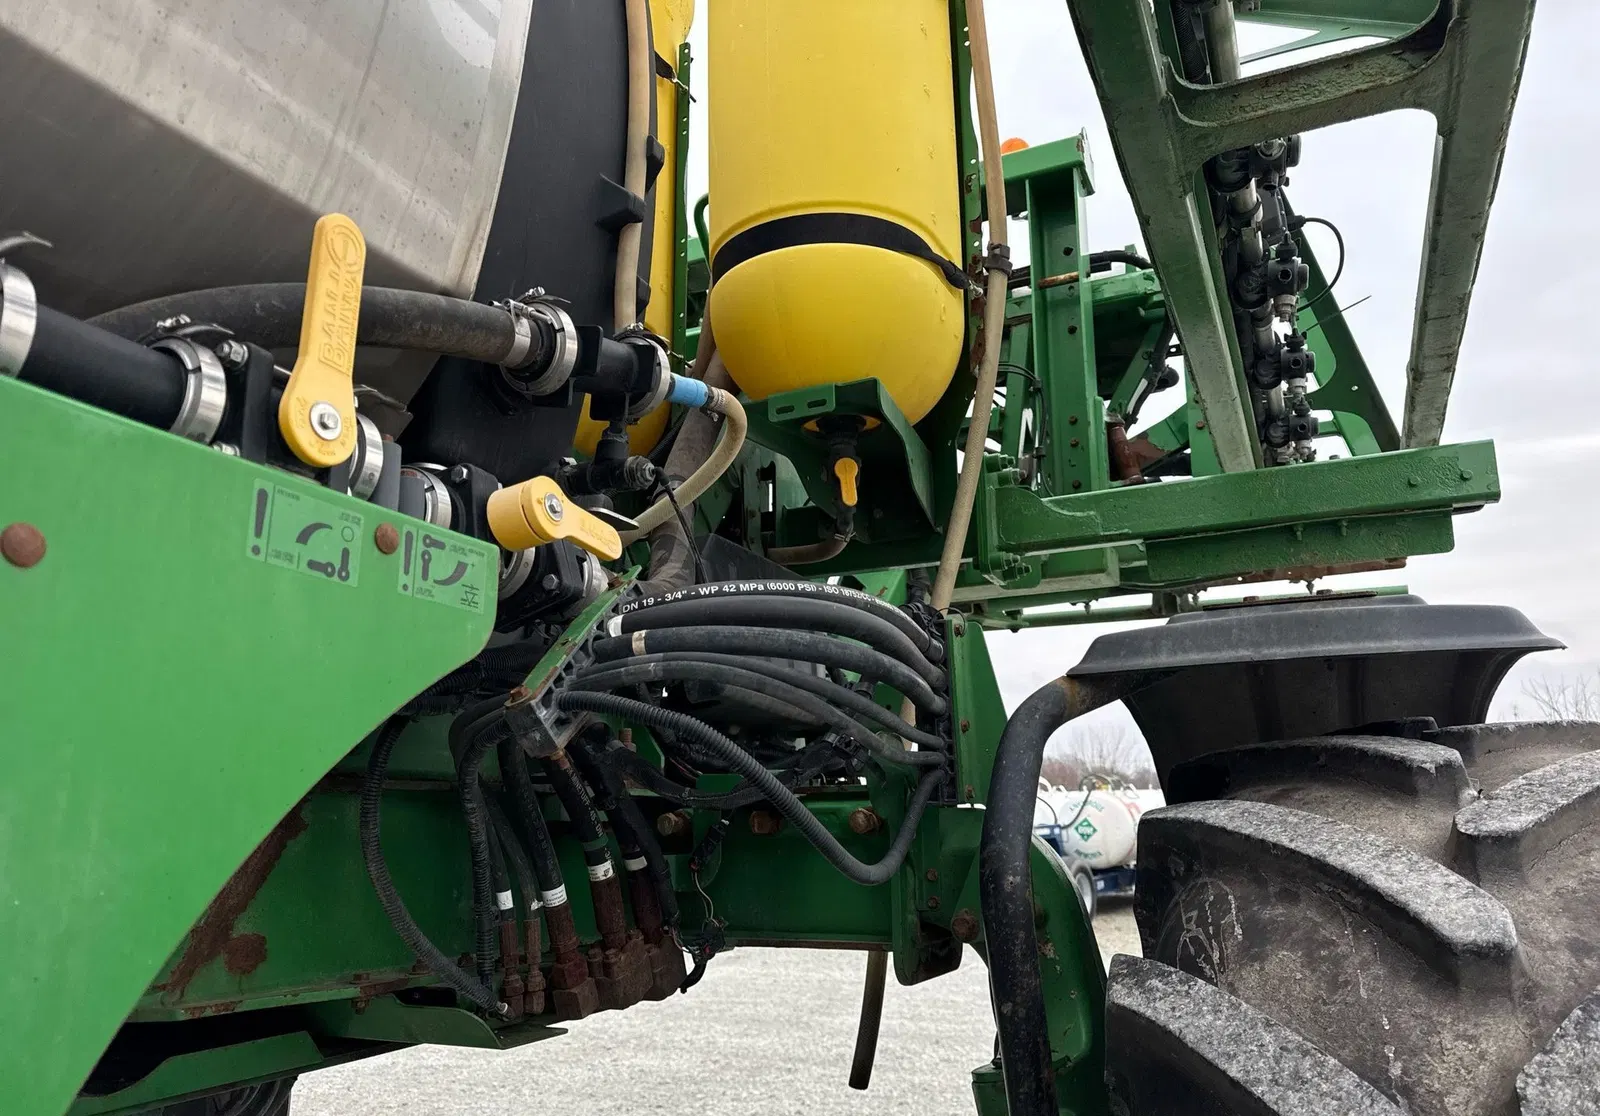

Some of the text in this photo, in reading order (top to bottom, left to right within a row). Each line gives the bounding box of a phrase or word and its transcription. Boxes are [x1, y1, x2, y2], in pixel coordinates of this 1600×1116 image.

[622, 602, 638, 613] DN
[642, 597, 654, 607] 19
[665, 590, 688, 602] 3/4"
[698, 585, 719, 595] WP
[722, 583, 737, 593] 42
[740, 582, 765, 592] MPa
[766, 582, 795, 591] (6000
[797, 583, 817, 592] PSI)
[824, 585, 839, 595] ISO
